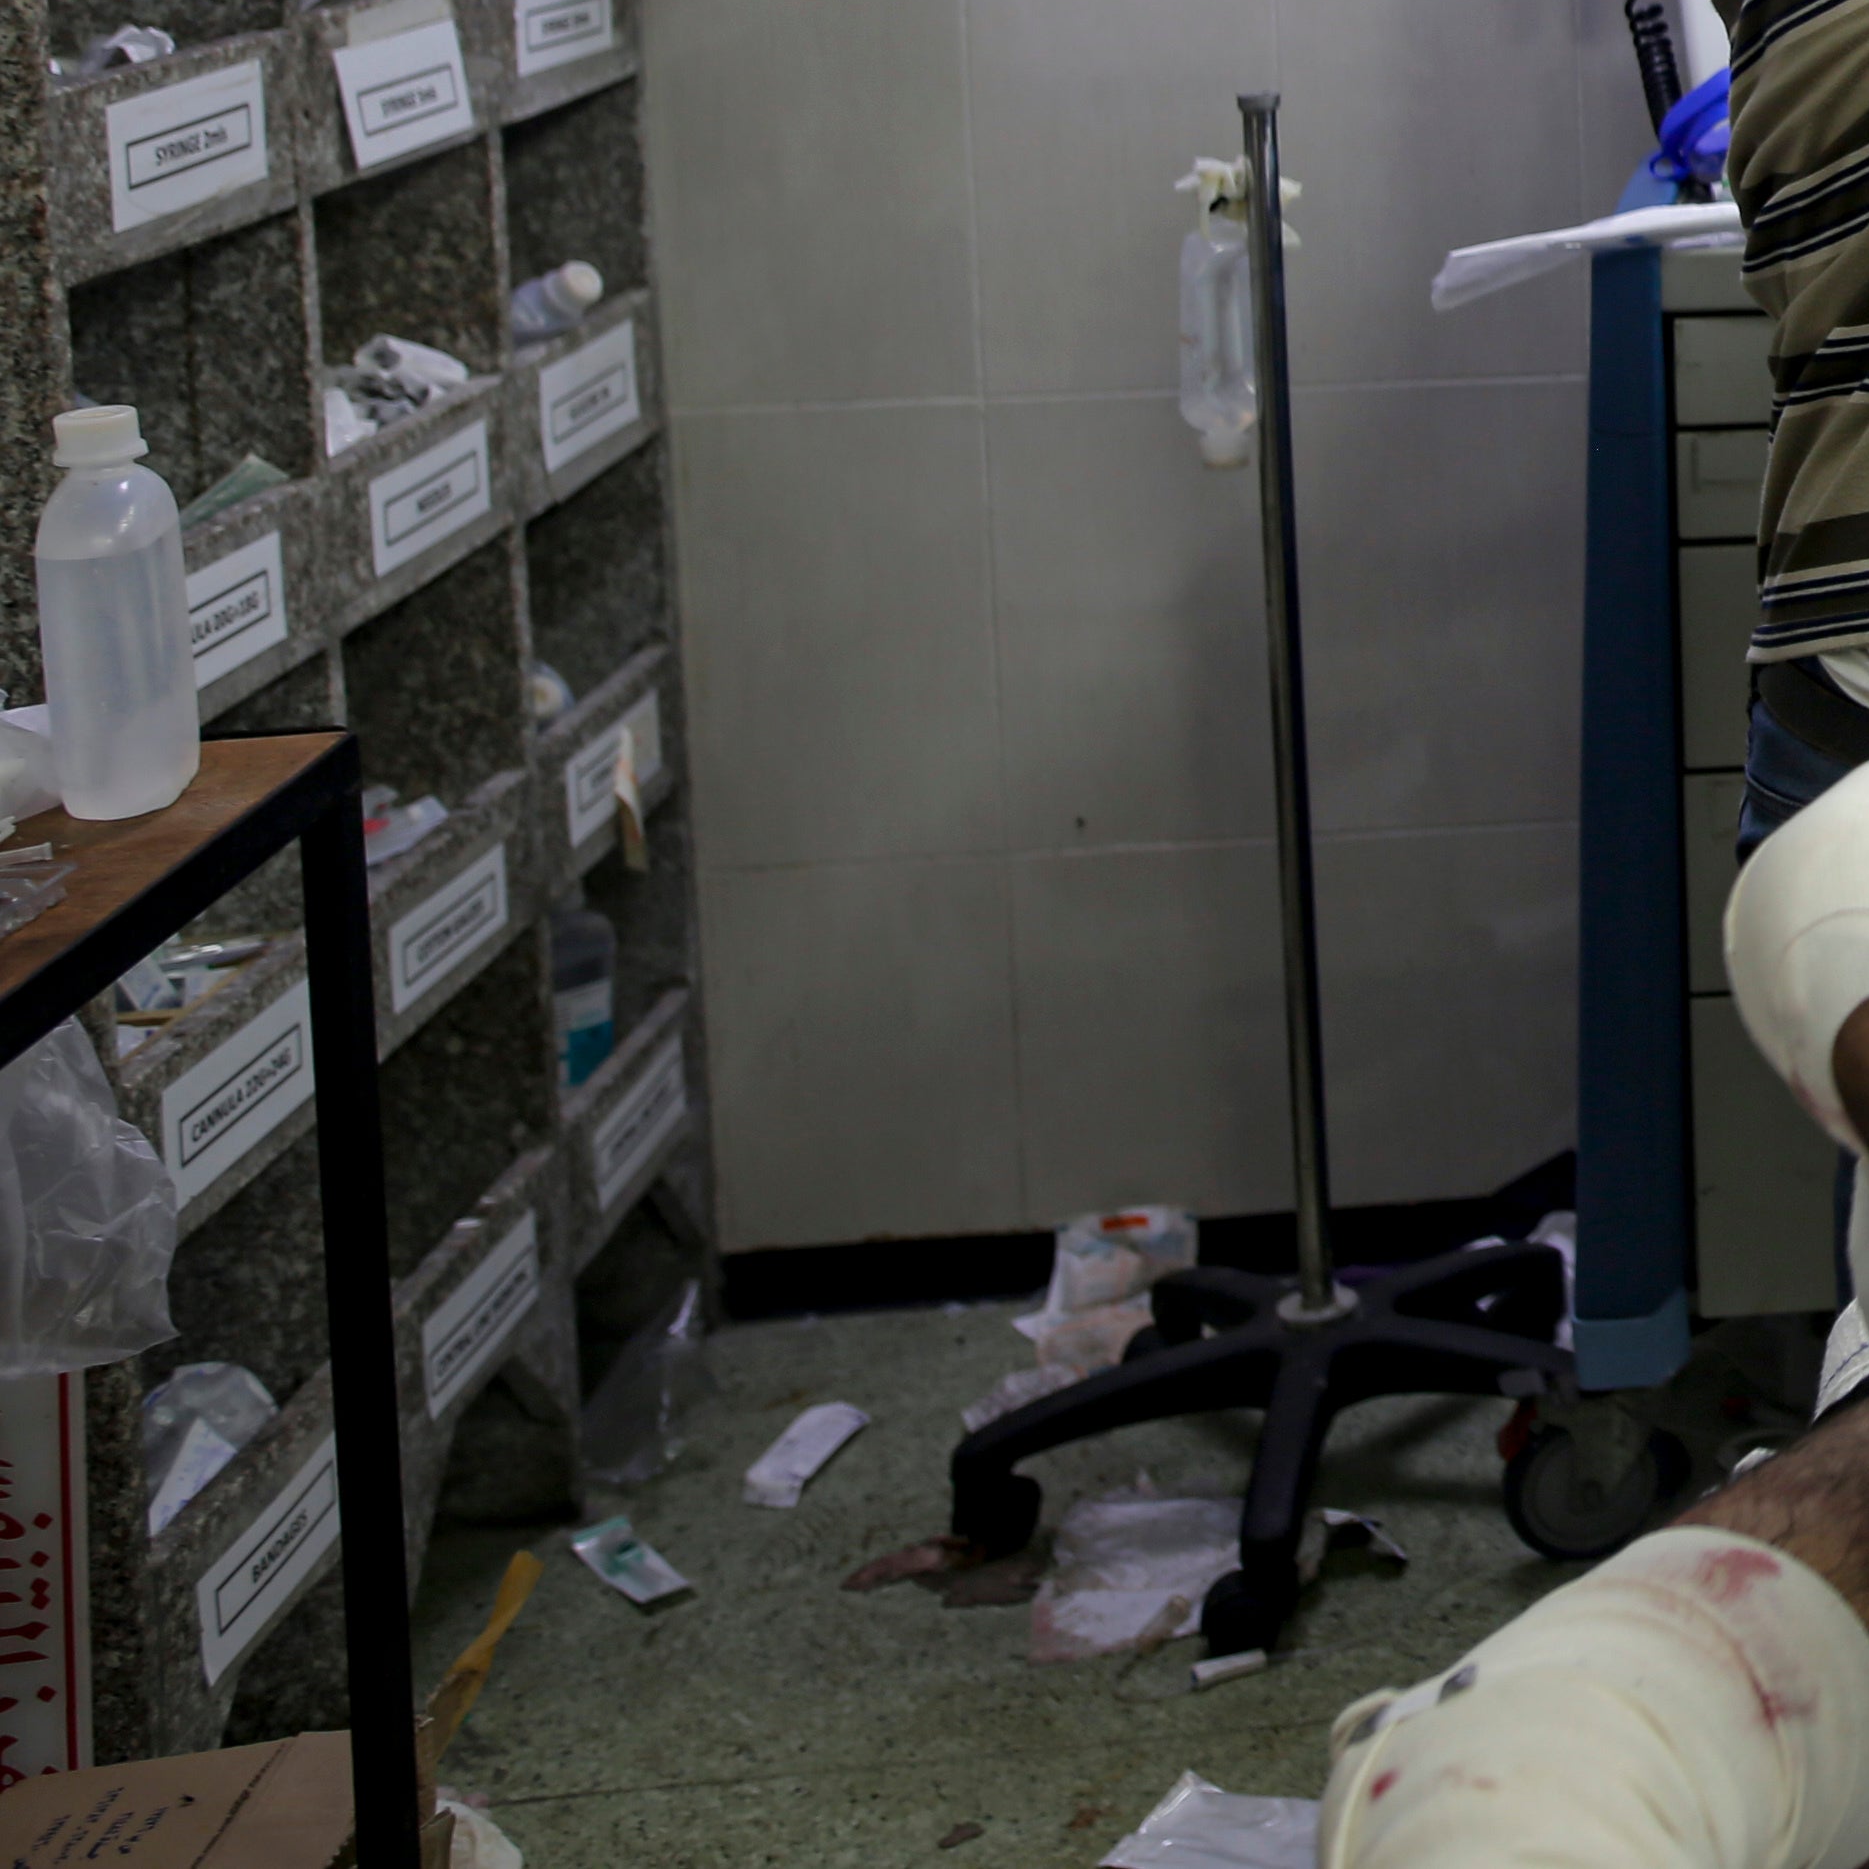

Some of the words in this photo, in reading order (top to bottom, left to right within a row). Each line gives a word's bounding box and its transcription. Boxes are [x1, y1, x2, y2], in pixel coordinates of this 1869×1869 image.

[155, 133, 202, 166] SYRINGE
[191, 1088, 244, 1143] CANNULA
[252, 1508, 308, 1583] BANDAGES
